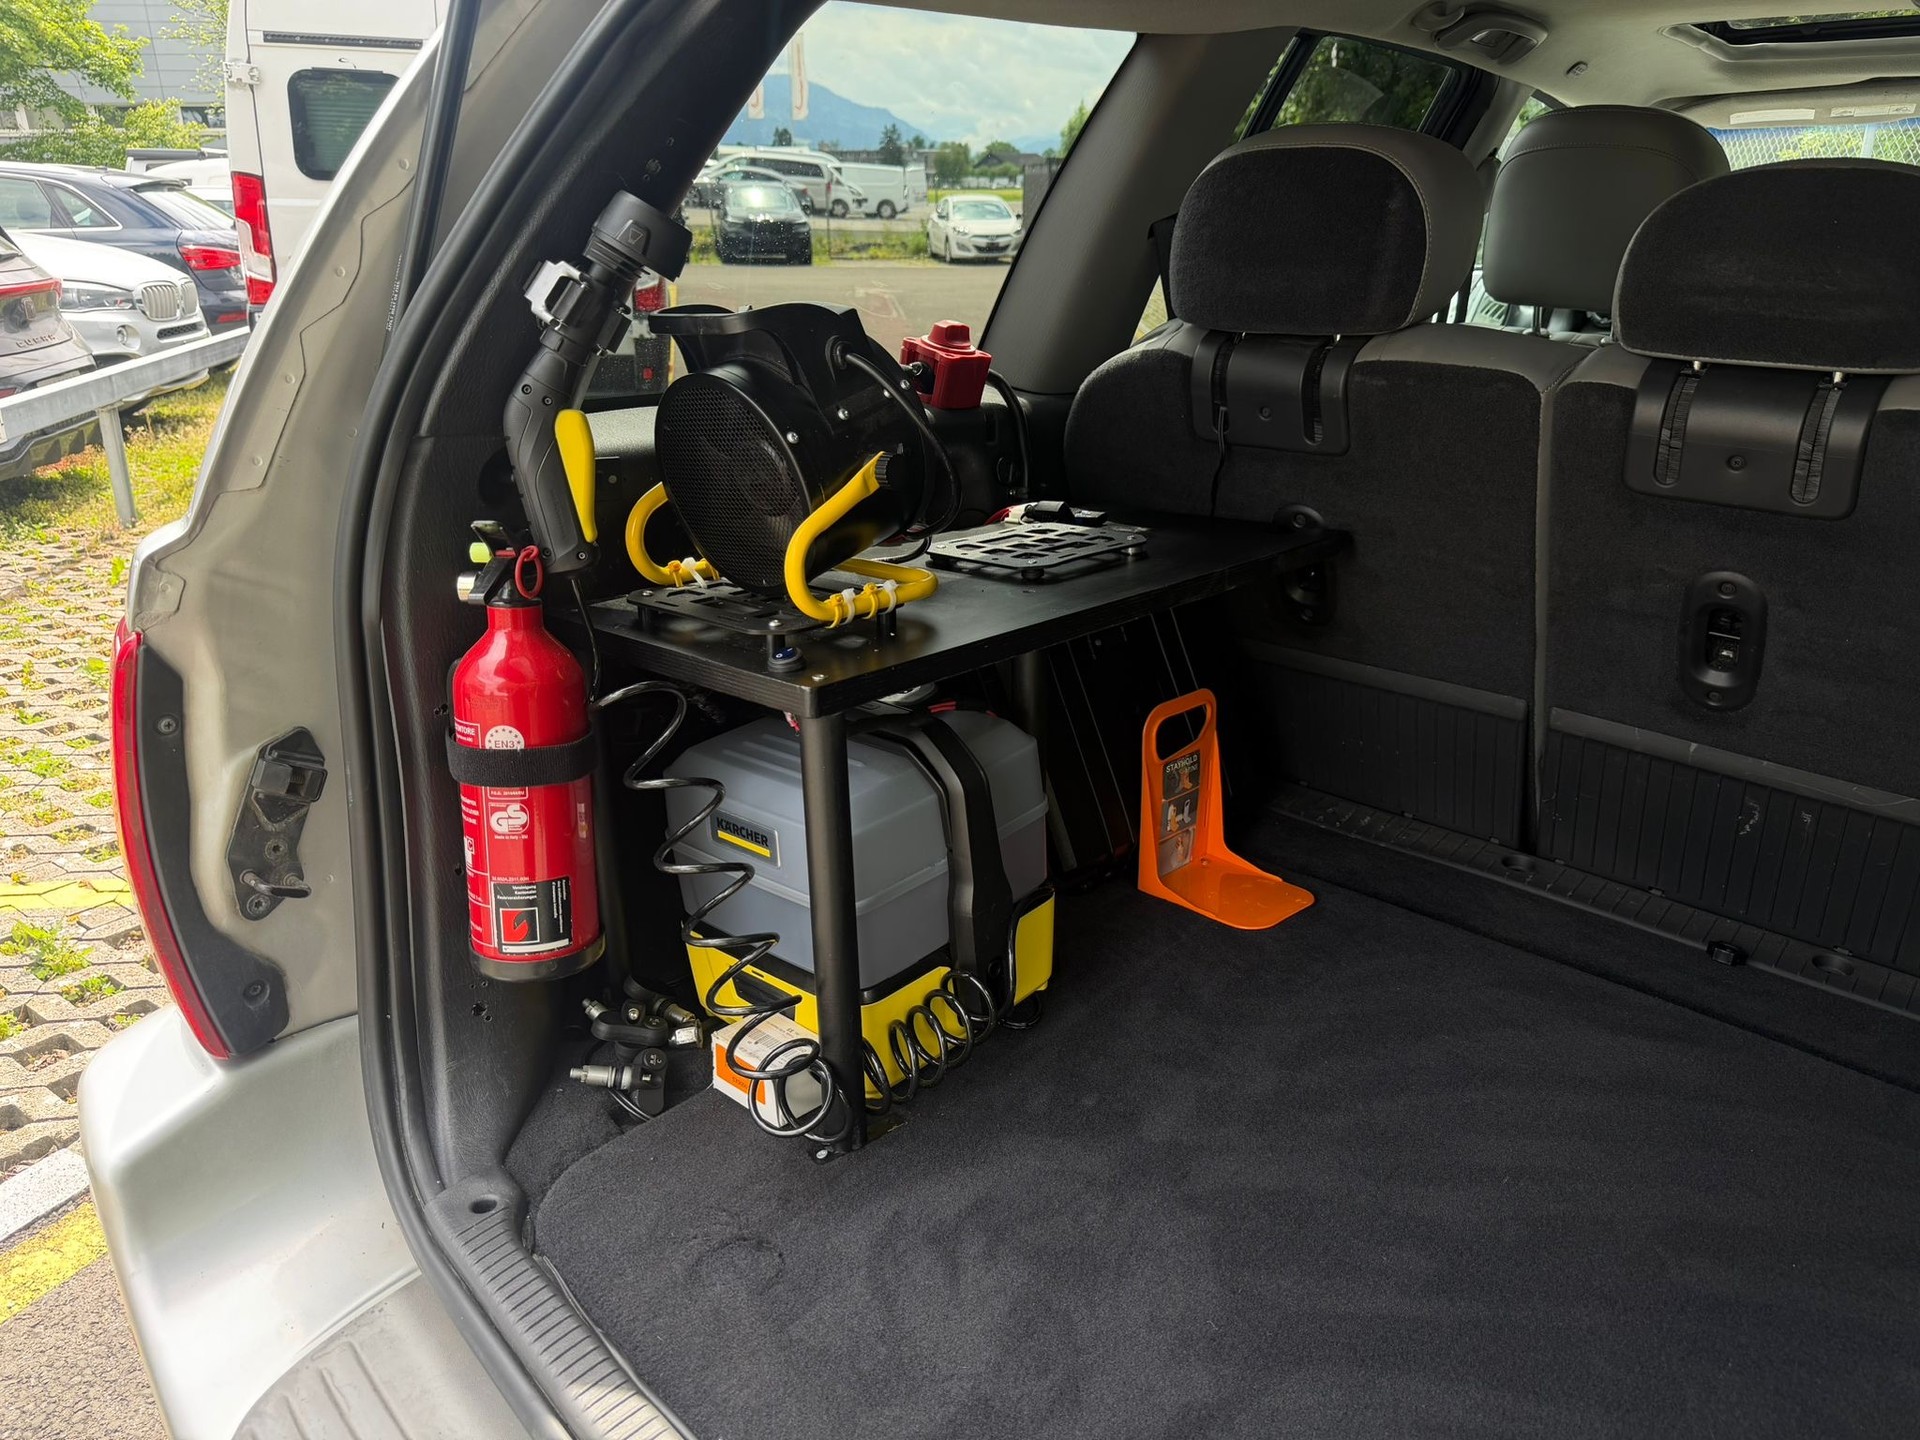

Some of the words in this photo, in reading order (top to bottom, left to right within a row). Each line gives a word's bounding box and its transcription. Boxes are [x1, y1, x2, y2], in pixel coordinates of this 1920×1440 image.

[494, 740, 515, 748] EN3
[1166, 754, 1197, 773] STAYHOLD
[490, 804, 528, 834] GS
[716, 817, 769, 847] KÄRCHER
